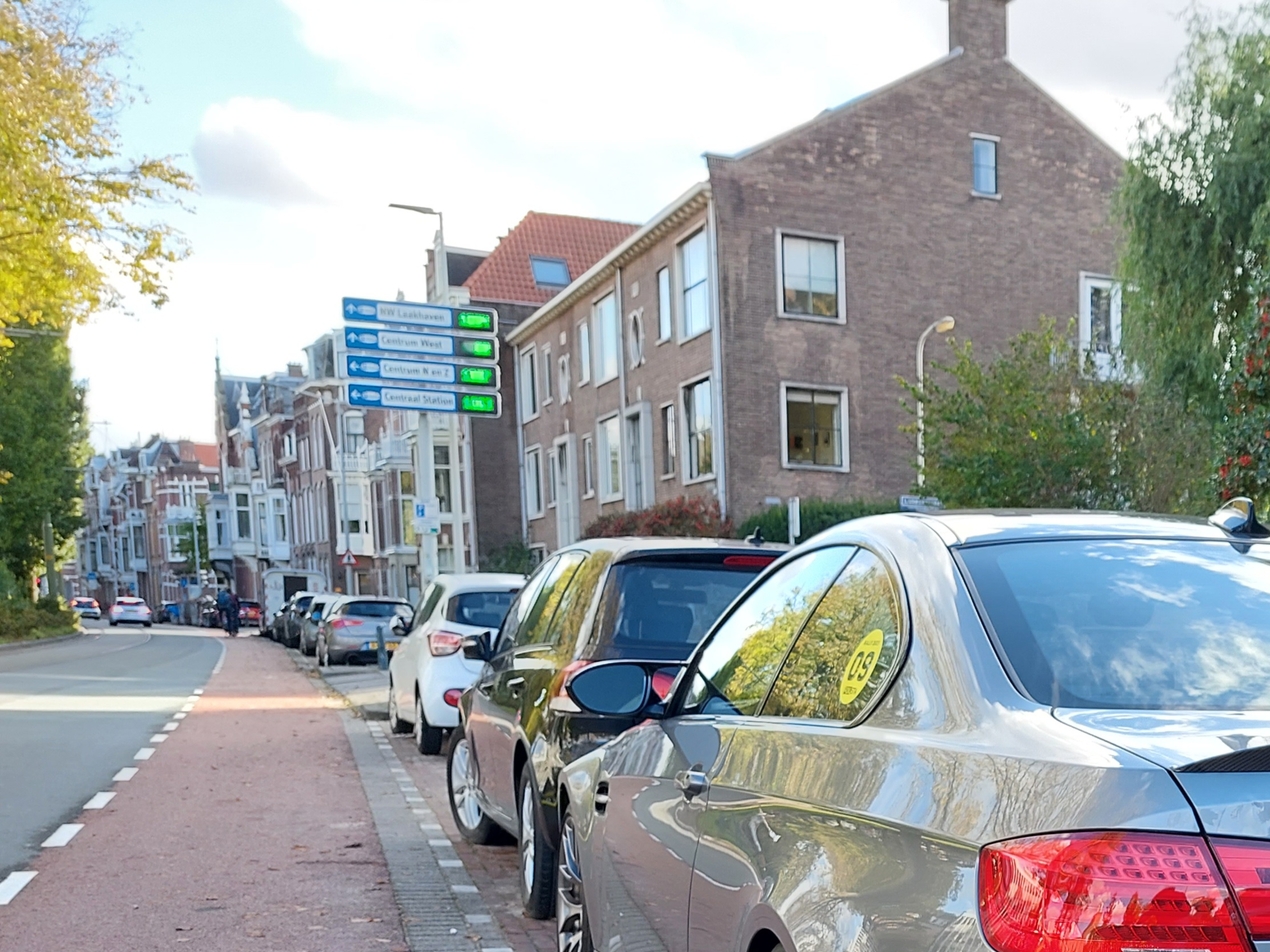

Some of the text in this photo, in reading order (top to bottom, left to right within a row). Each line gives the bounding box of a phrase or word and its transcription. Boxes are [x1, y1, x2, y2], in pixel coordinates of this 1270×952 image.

[380, 306, 396, 316] NW
[382, 336, 418, 347] Centrum
[420, 337, 442, 349] West
[384, 364, 420, 376] Centrum
[385, 392, 420, 403] Centraal
[423, 394, 454, 407] Station
